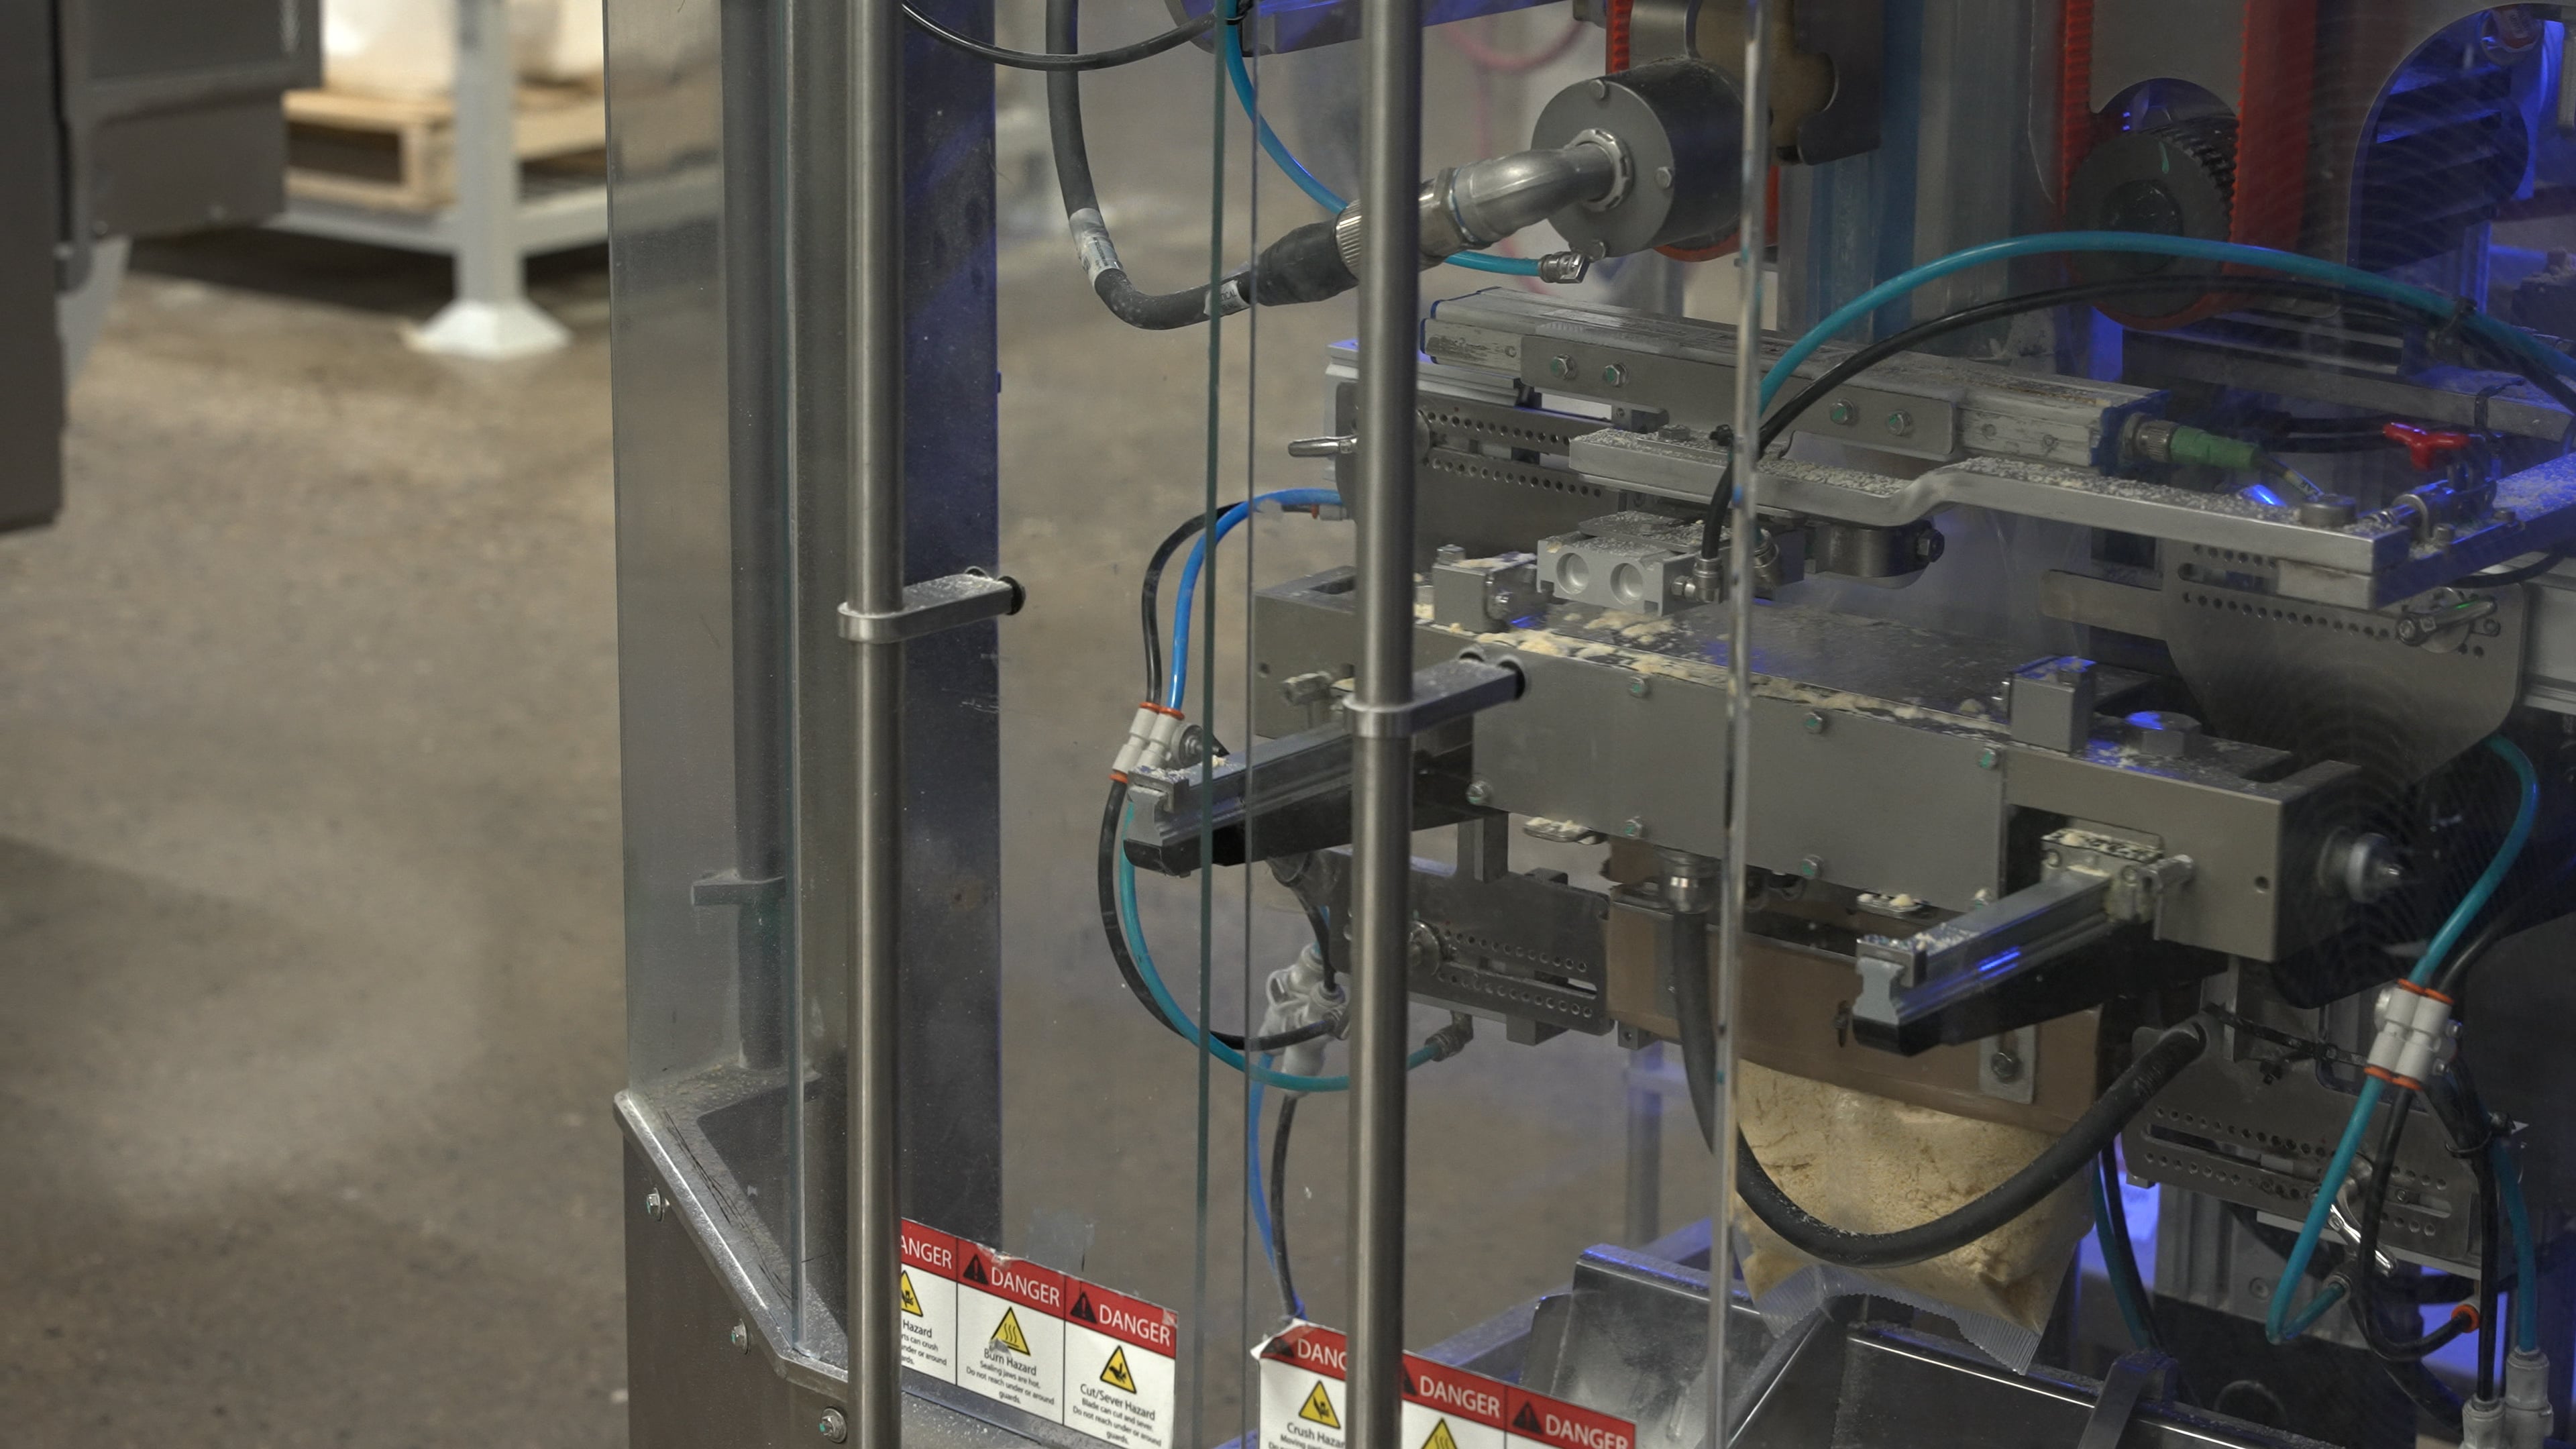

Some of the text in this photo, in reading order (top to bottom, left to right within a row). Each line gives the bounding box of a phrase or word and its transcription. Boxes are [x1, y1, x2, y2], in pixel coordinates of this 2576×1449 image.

[901, 1235, 952, 1269] ANGER
[991, 1267, 1059, 1307] DANGER
[903, 1319, 932, 1338] Hazard
[1099, 1303, 1170, 1347] DANGER
[910, 1336, 921, 1346] can
[922, 1341, 938, 1352] crush
[926, 1352, 947, 1366] around
[1297, 1338, 1346, 1371] DANG
[980, 1360, 1002, 1377] Sealing
[1018, 1376, 1028, 1384] are
[1028, 1378, 1040, 1389] hot.
[984, 1348, 1036, 1376] Burn Hazard
[966, 1366, 975, 1375] Do
[976, 1371, 987, 1381] not
[988, 1375, 1004, 1387] reach
[1006, 1383, 1023, 1393] under
[1032, 1392, 1055, 1405] around
[999, 1391, 1021, 1404] guards.
[1080, 1383, 1155, 1421] Cut/Sever Hazard
[1419, 1375, 1500, 1419] DANGER
[1073, 1405, 1082, 1415] Do
[1083, 1411, 1093, 1420] not
[1095, 1415, 1112, 1426] reach
[1114, 1423, 1132, 1434] under
[1140, 1433, 1161, 1447] around
[1100, 1406, 1112, 1415] can
[1113, 1411, 1122, 1419] cut
[1124, 1415, 1135, 1424] and
[1546, 1413, 1629, 1449] DANGER
[1287, 1421, 1346, 1449] Crush Hazar
